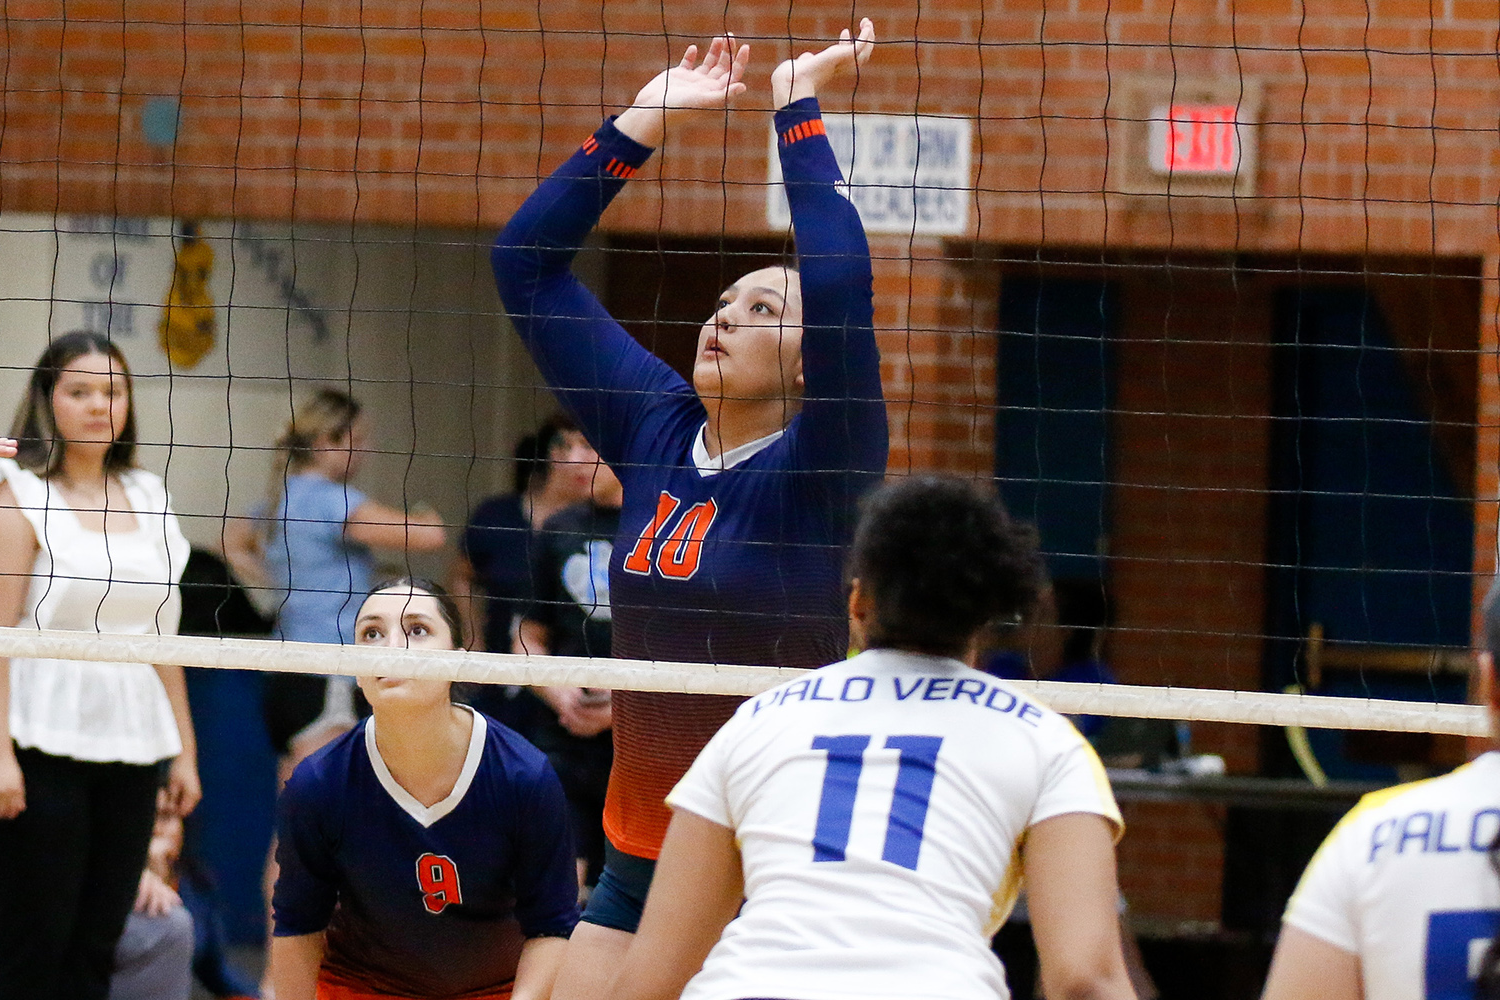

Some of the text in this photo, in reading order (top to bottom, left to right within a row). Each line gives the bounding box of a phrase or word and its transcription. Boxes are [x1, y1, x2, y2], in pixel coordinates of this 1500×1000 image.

[1164, 105, 1236, 172] EXIT
[624, 490, 718, 581] 10
[751, 675, 1044, 728] PALO VERDE
[811, 734, 944, 872] 11
[1366, 805, 1500, 864] PALO
[415, 852, 463, 915] 9
